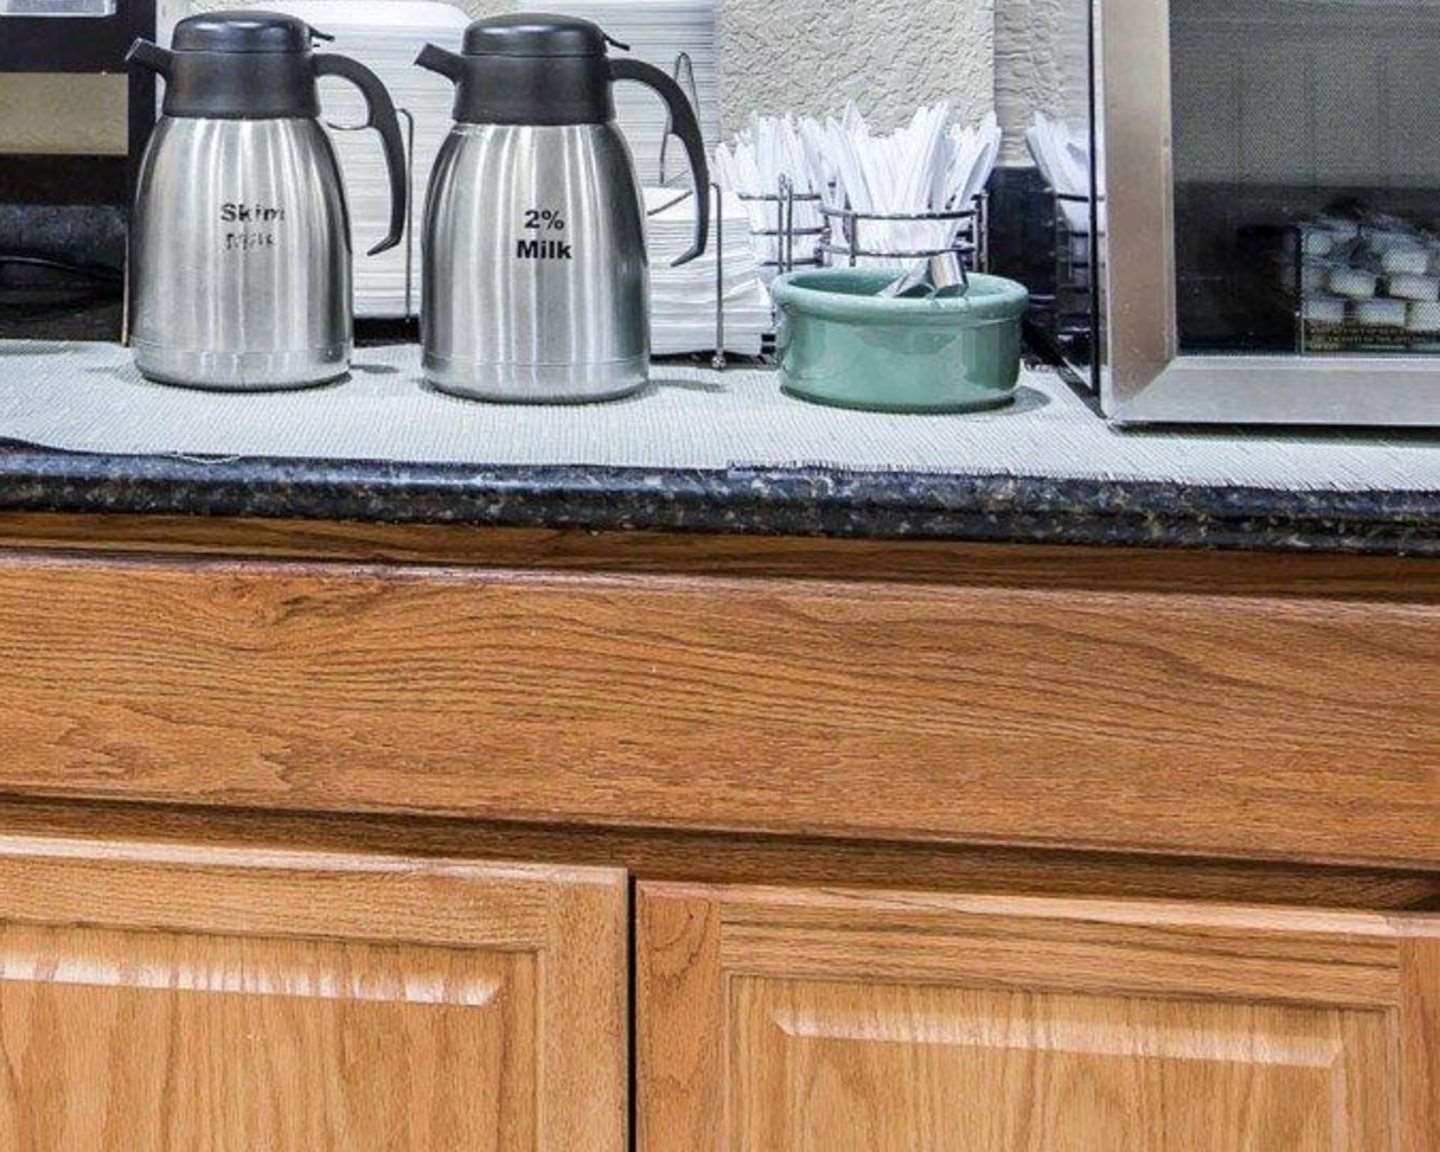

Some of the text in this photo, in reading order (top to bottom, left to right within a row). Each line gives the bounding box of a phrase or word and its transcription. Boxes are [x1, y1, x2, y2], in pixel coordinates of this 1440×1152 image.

[220, 202, 285, 222] Skim
[524, 209, 565, 231] 2%
[517, 239, 573, 260] Milk
